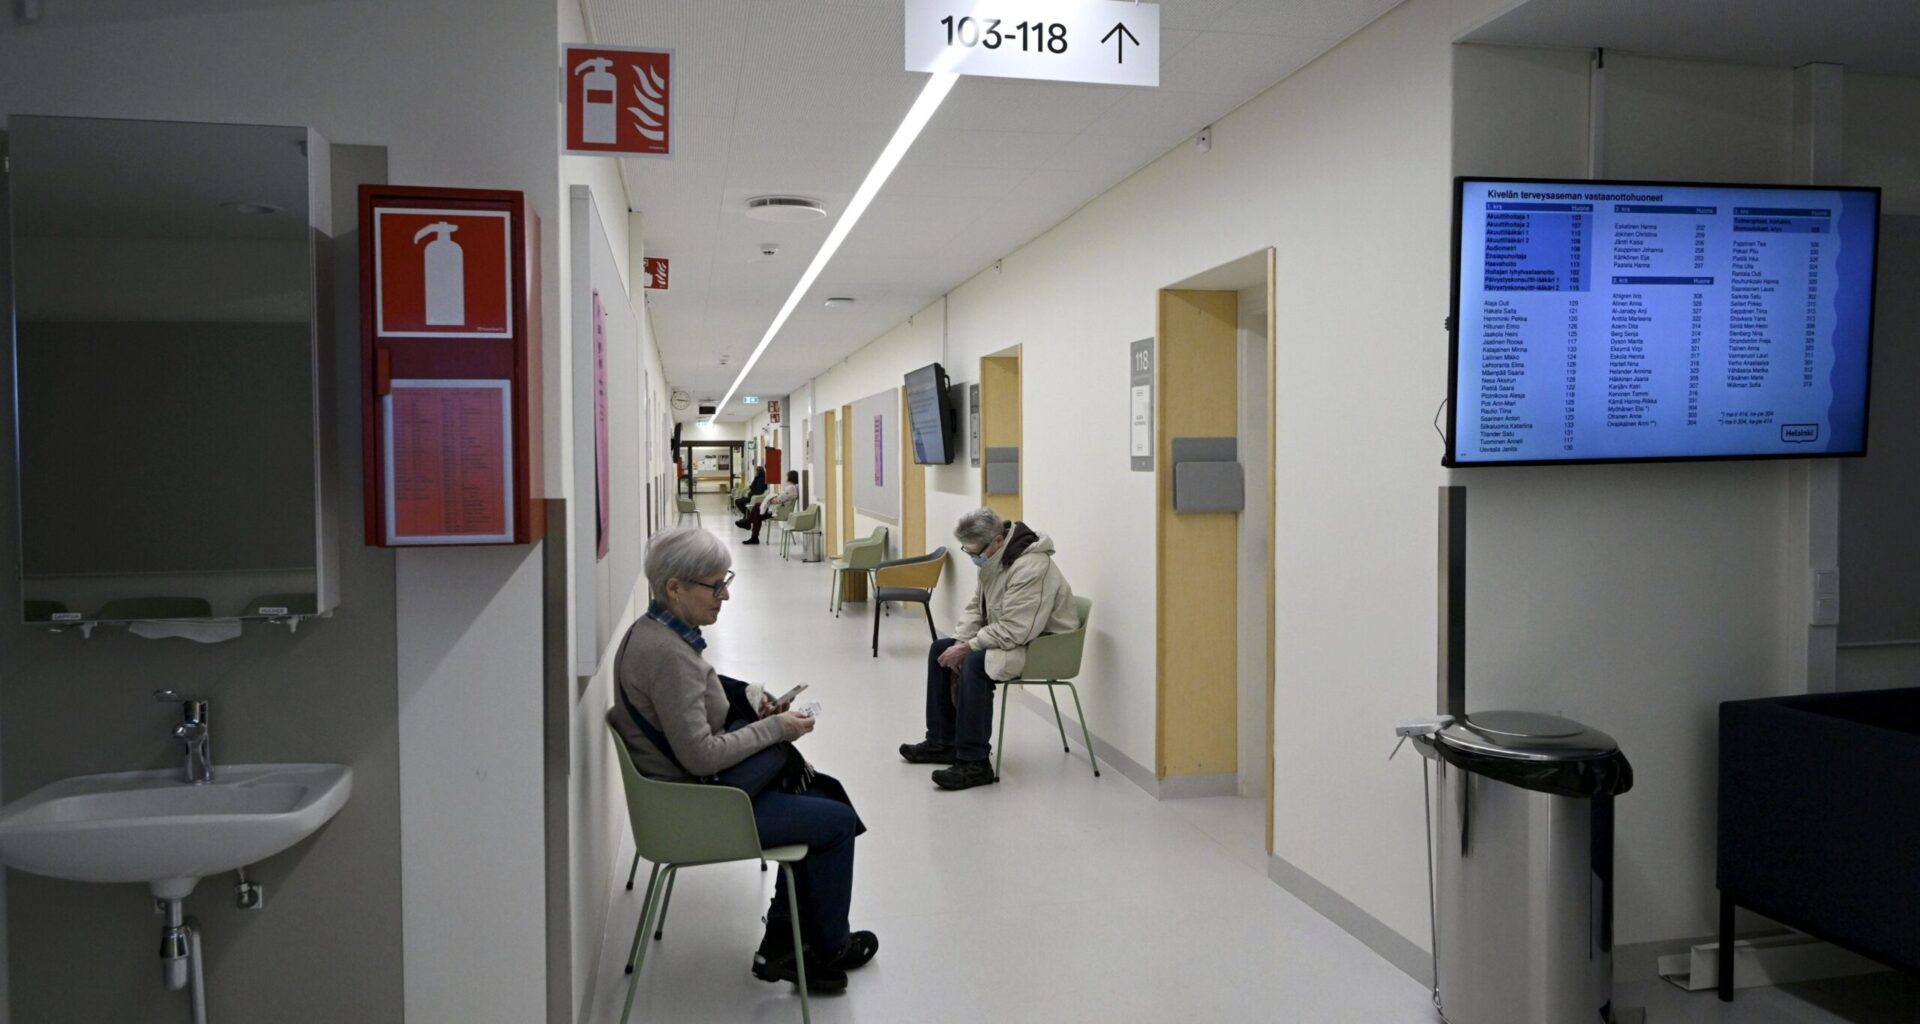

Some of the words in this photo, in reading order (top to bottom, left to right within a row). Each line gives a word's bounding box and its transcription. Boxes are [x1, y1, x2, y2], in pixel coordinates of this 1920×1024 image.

[940, 15, 1068, 54] 103-118
[1488, 190, 1519, 199] Kivelän
[1521, 191, 1582, 201] terveysaseman
[1584, 193, 1663, 202] vastaanottohuoneet
[1136, 350, 1149, 372] 118
[1785, 429, 1814, 437] Helsinki
